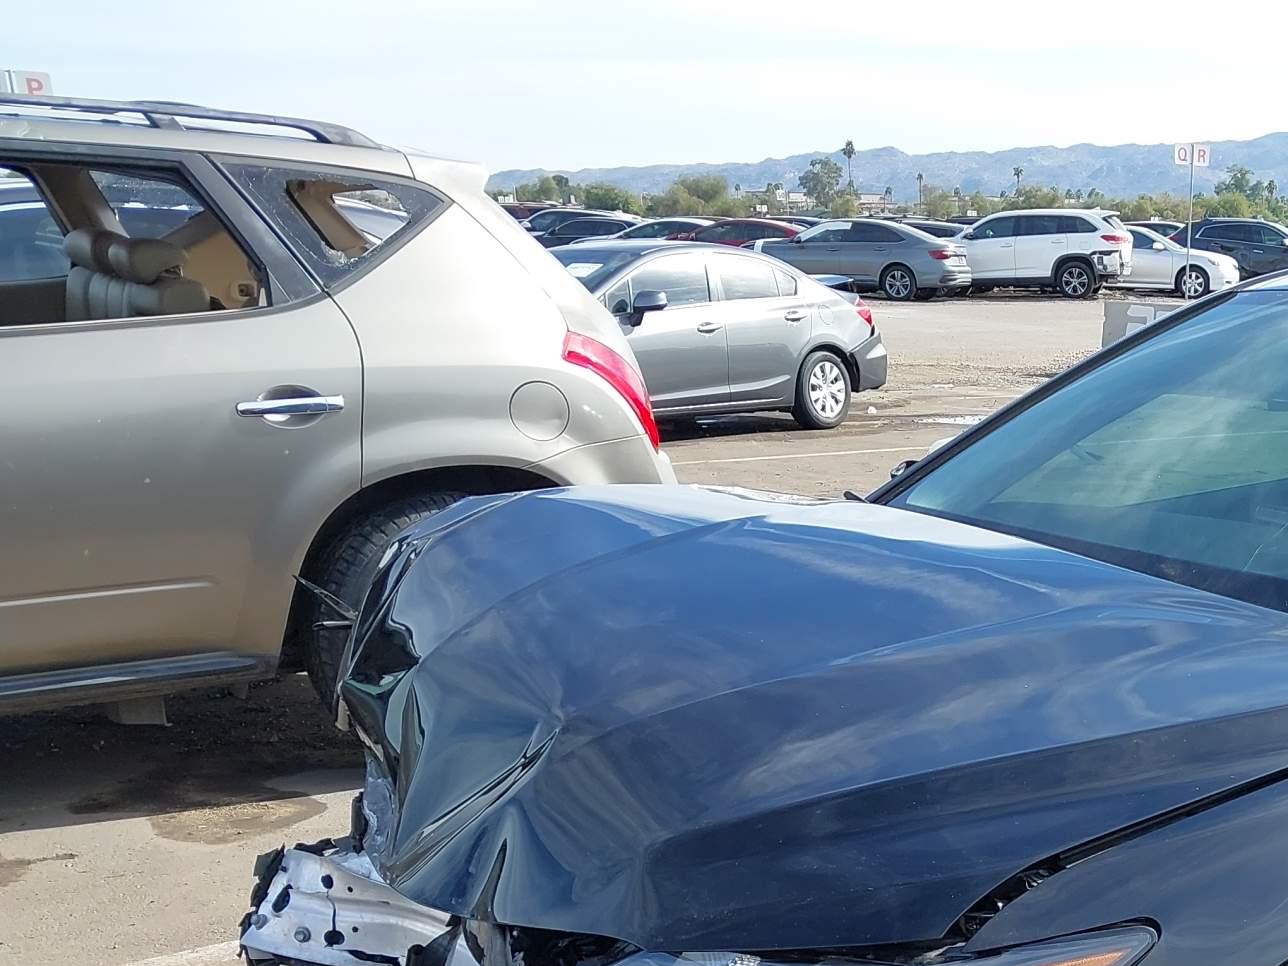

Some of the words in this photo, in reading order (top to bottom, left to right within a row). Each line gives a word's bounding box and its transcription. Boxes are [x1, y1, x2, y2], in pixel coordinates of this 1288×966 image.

[25, 77, 44, 95] P
[1177, 147, 1188, 162] Q
[1197, 148, 1206, 164] R
